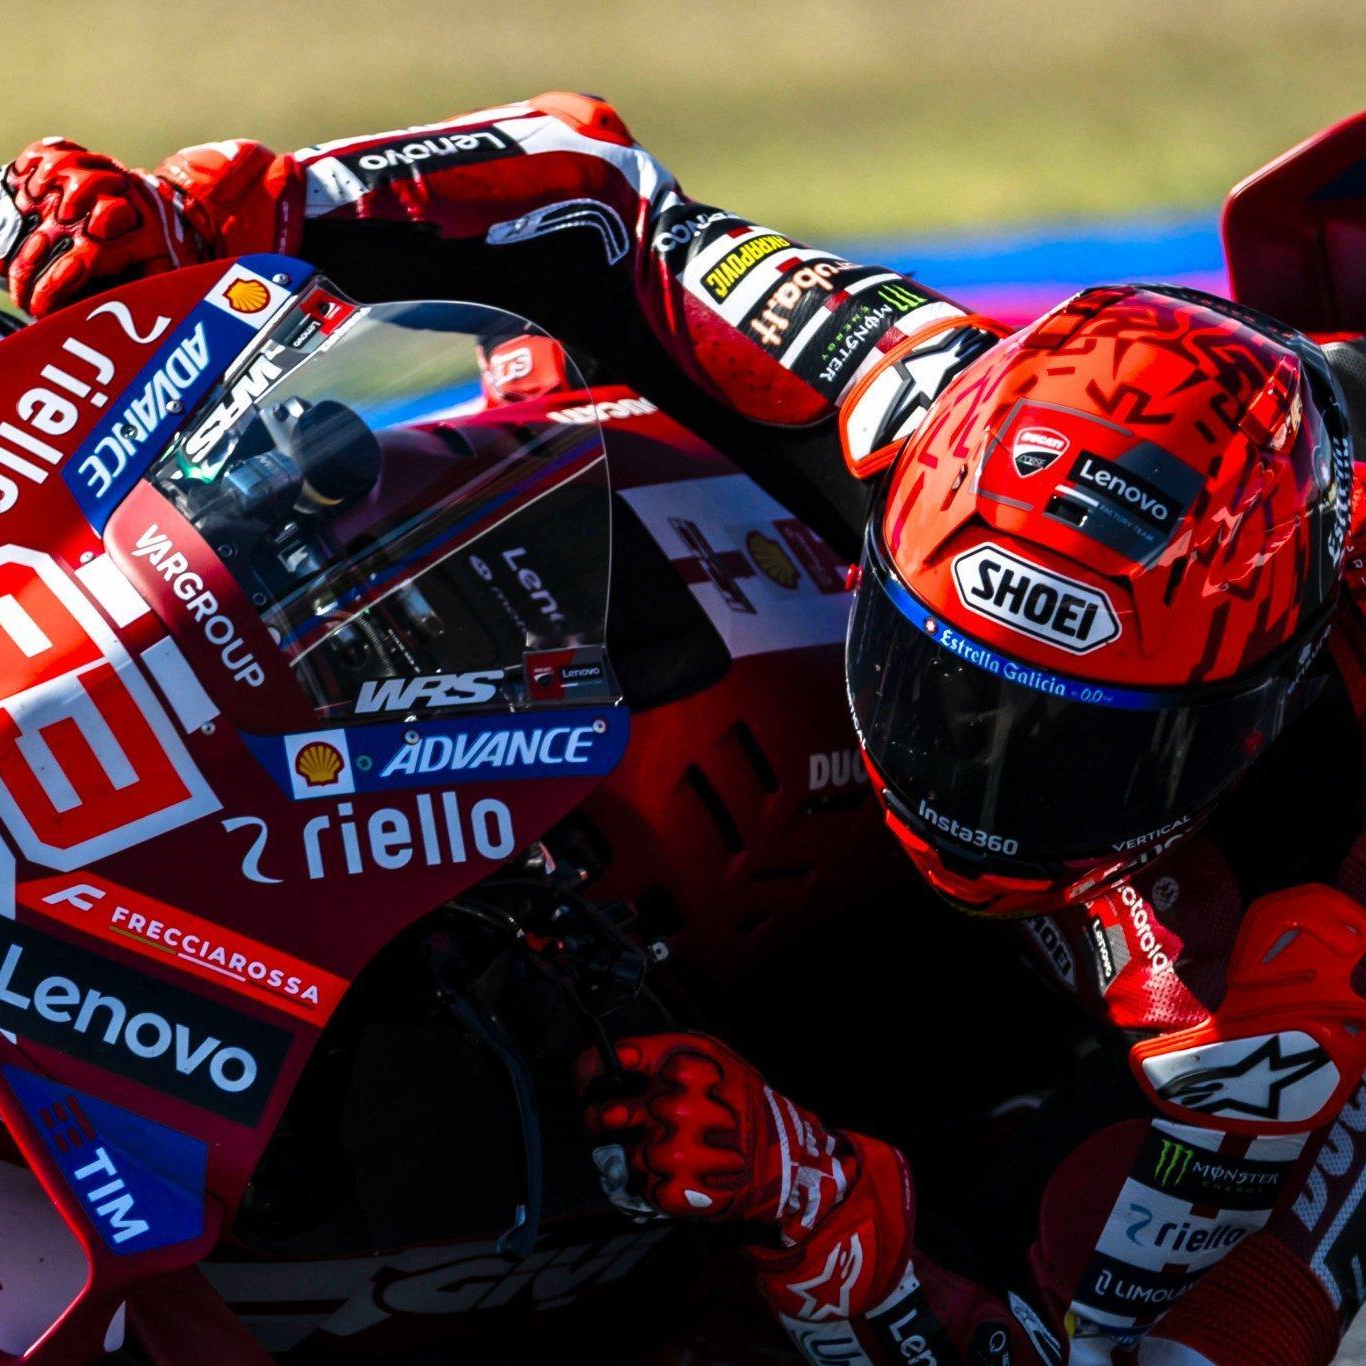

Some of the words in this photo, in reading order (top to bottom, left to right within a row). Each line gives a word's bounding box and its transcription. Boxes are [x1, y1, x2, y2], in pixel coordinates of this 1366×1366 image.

[358, 131, 508, 171] Lenovo
[292, 320, 322, 348] Lenovo
[819, 303, 893, 383] MONSTER
[76, 321, 211, 499] ADVANCE
[184, 354, 283, 464] WRS
[1079, 458, 1169, 521] Lenovo
[130, 523, 266, 689] VARGROUP
[968, 558, 1098, 641] SHOEI
[353, 669, 505, 714] WRS
[561, 666, 601, 679] Lenovo
[939, 628, 1001, 674] Estrella
[1003, 661, 1067, 697] Galicia
[378, 725, 596, 778] ADVANCE
[302, 790, 516, 880] riello
[918, 799, 1019, 856] Insta360
[1111, 815, 1191, 851] VERTICAL
[109, 905, 321, 1005] FRECCIAROSSA
[1117, 885, 1175, 975] otorola
[72, 1147, 151, 1245] TIM
[1192, 1161, 1282, 1185] MONSTER
[1153, 1221, 1248, 1252] riello
